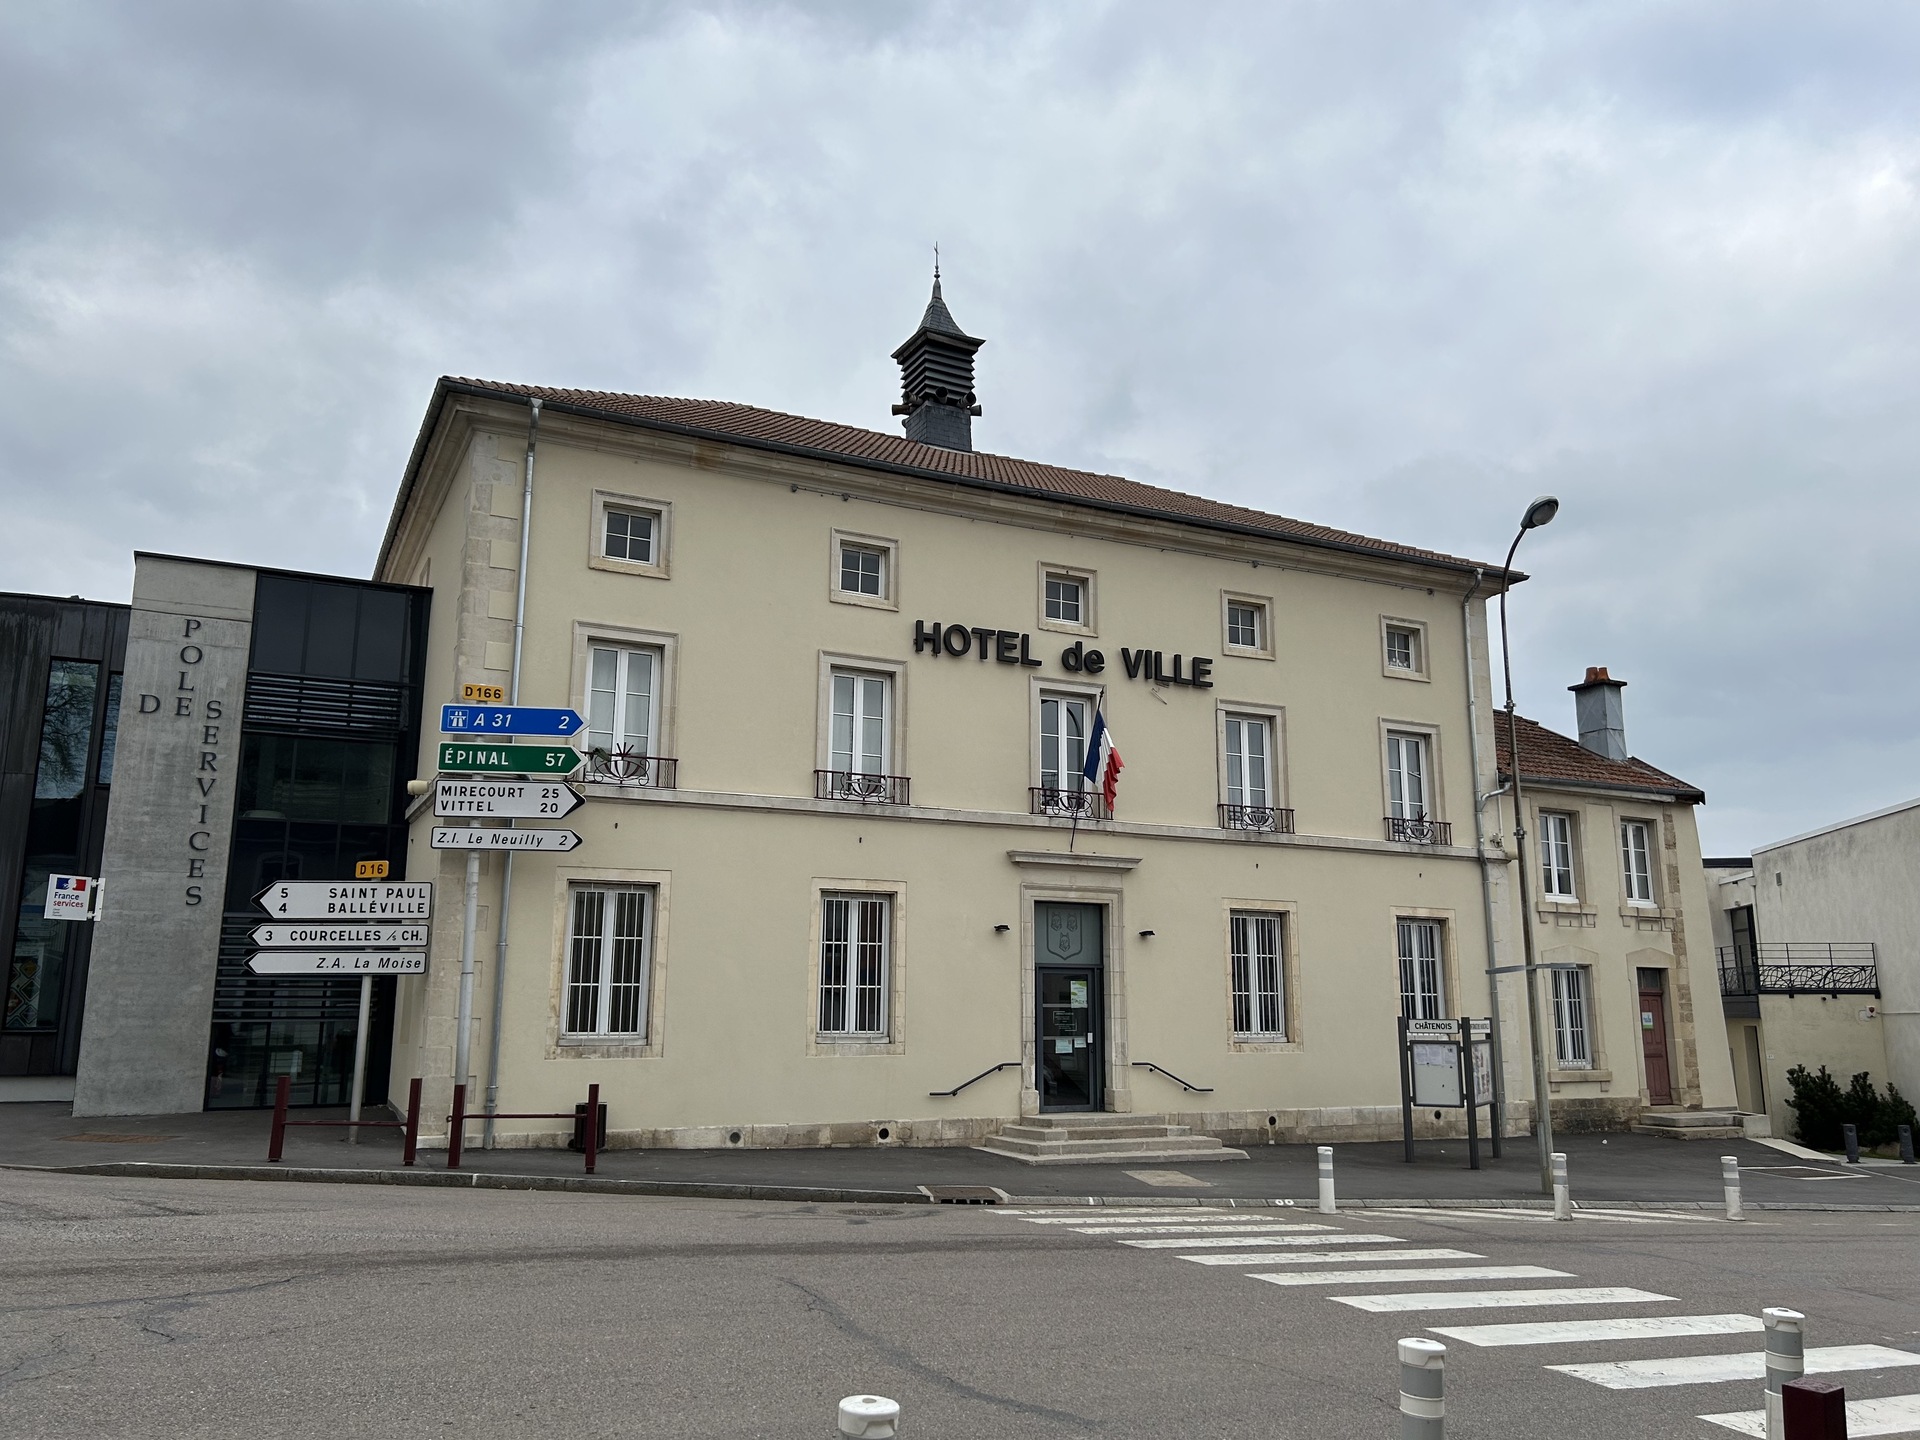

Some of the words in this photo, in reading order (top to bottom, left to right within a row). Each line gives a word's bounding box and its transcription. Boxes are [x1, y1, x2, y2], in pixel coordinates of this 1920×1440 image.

[915, 619, 1042, 667] HOTEL
[1062, 641, 1105, 674] de
[1121, 647, 1214, 688] VILLE
[473, 713, 485, 727] A
[492, 713, 512, 728] 31
[558, 716, 570, 729] 2
[444, 747, 509, 765] ÉPINAL
[545, 753, 566, 767] 57
[441, 785, 525, 798] MIRECOURT
[541, 788, 560, 799] 25
[185, 700, 223, 906] SERVICES
[441, 800, 494, 812] VITTEL
[540, 802, 559, 813] 20
[437, 832, 459, 844] Z.I.
[468, 833, 483, 844] Le
[490, 834, 544, 847] Neuilly
[559, 835, 568, 846] 2
[53, 892, 80, 900] France
[280, 887, 289, 898] 5
[329, 887, 378, 898] SAINT
[386, 887, 426, 898] PAUL
[53, 900, 84, 908] services
[278, 902, 288, 914] 4
[328, 900, 425, 914] BALLÉVILLE
[264, 930, 273, 941] 3
[290, 930, 381, 941] COURCELLES
[401, 930, 423, 941] CH.
[316, 957, 345, 969] Z.A.
[354, 957, 370, 969] La
[378, 957, 421, 969] Moise
[1414, 1021, 1452, 1030] CHÂTENOIS
